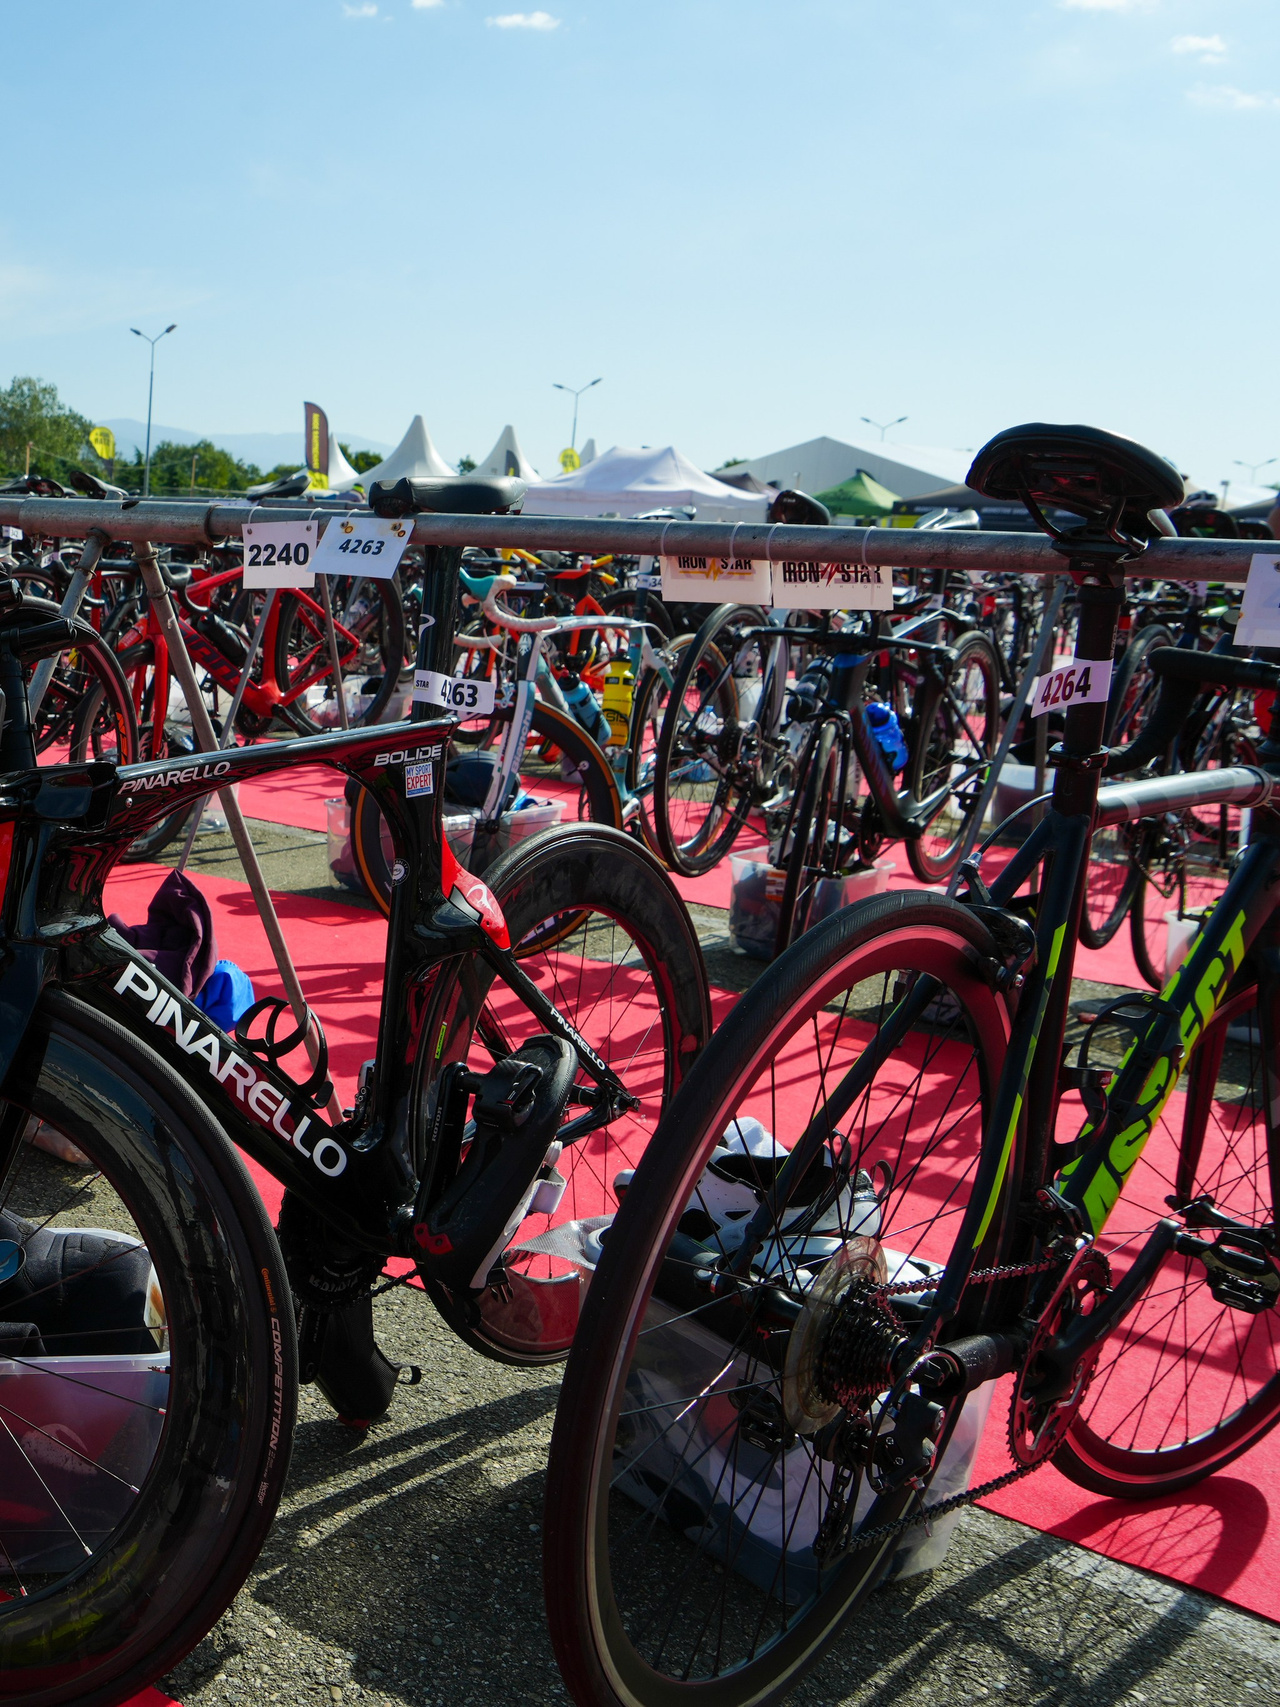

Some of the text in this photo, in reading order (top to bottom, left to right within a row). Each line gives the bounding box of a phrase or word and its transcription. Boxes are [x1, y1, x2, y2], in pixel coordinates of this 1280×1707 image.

[248, 542, 309, 567] 2240
[338, 539, 385, 556] 4263
[678, 556, 707, 569] IRON
[782, 561, 882, 583] IRON STAR
[415, 679, 429, 688] STAR
[1040, 666, 1091, 708] 4264
[373, 744, 443, 767] BOLIDE
[119, 761, 231, 796] PINARELLO
[406, 764, 431, 776] MY SPORT
[406, 773, 432, 790] EXPERT
[549, 1006, 606, 1071] PINARELLO
[113, 960, 348, 1178] PINARELLO
[431, 1106, 443, 1142] ROTOR
[260, 1267, 276, 1308] Continental
[268, 1316, 285, 1451] COMPETITION
